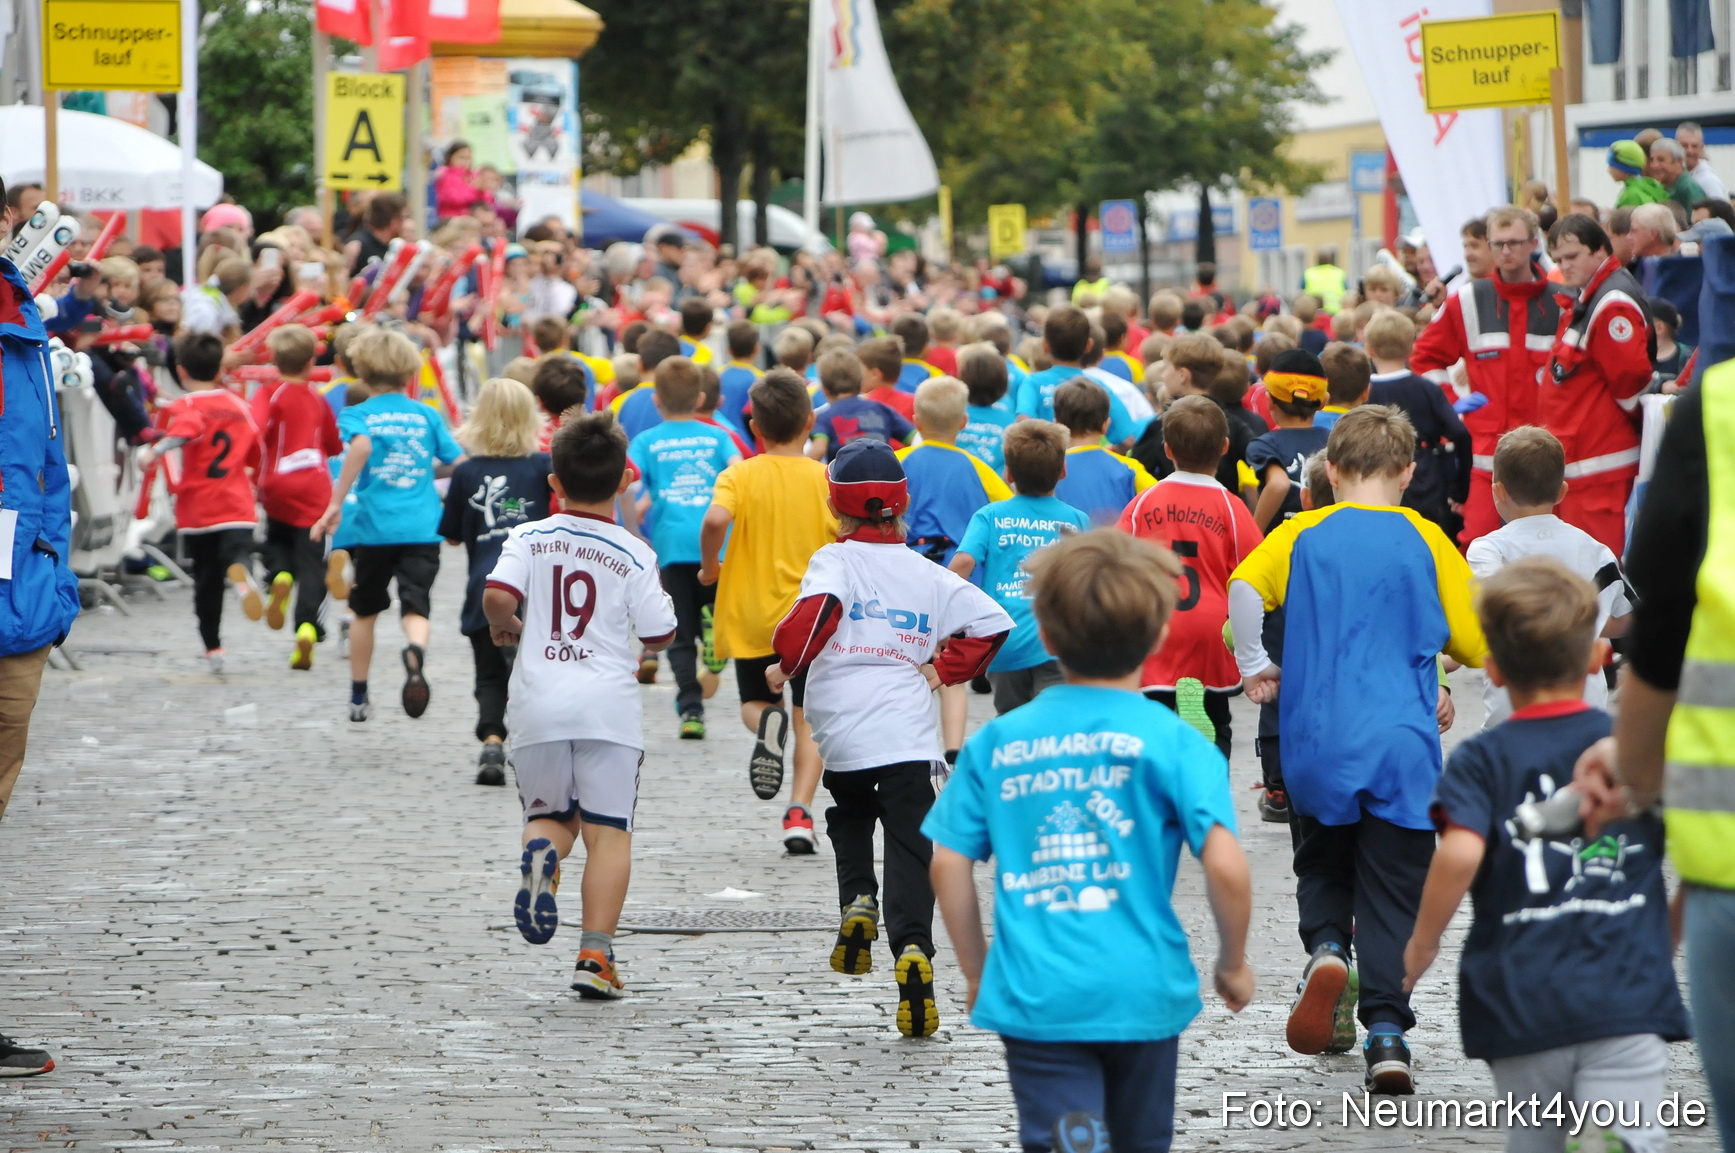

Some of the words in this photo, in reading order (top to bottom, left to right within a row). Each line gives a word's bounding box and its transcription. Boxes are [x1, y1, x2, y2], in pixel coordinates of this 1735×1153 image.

[53, 22, 174, 44] Schnupper-
[94, 49, 133, 65] lauf
[1431, 41, 1549, 63] Schnupper-
[334, 77, 395, 98] Block
[1473, 66, 1511, 84] lauf
[343, 109, 382, 162] A
[80, 187, 125, 202] BKK
[207, 431, 231, 478] 2
[1144, 507, 1163, 530] FC
[530, 540, 571, 556] BAYERN
[575, 546, 632, 579] MÜNCHEN
[1171, 540, 1201, 612] 5
[551, 564, 597, 641] 19
[831, 641, 846, 654] Ihr
[991, 731, 1145, 769] NEUMARKTER
[1000, 765, 1132, 802] STADTLAUF
[1086, 790, 1135, 838] 2014
